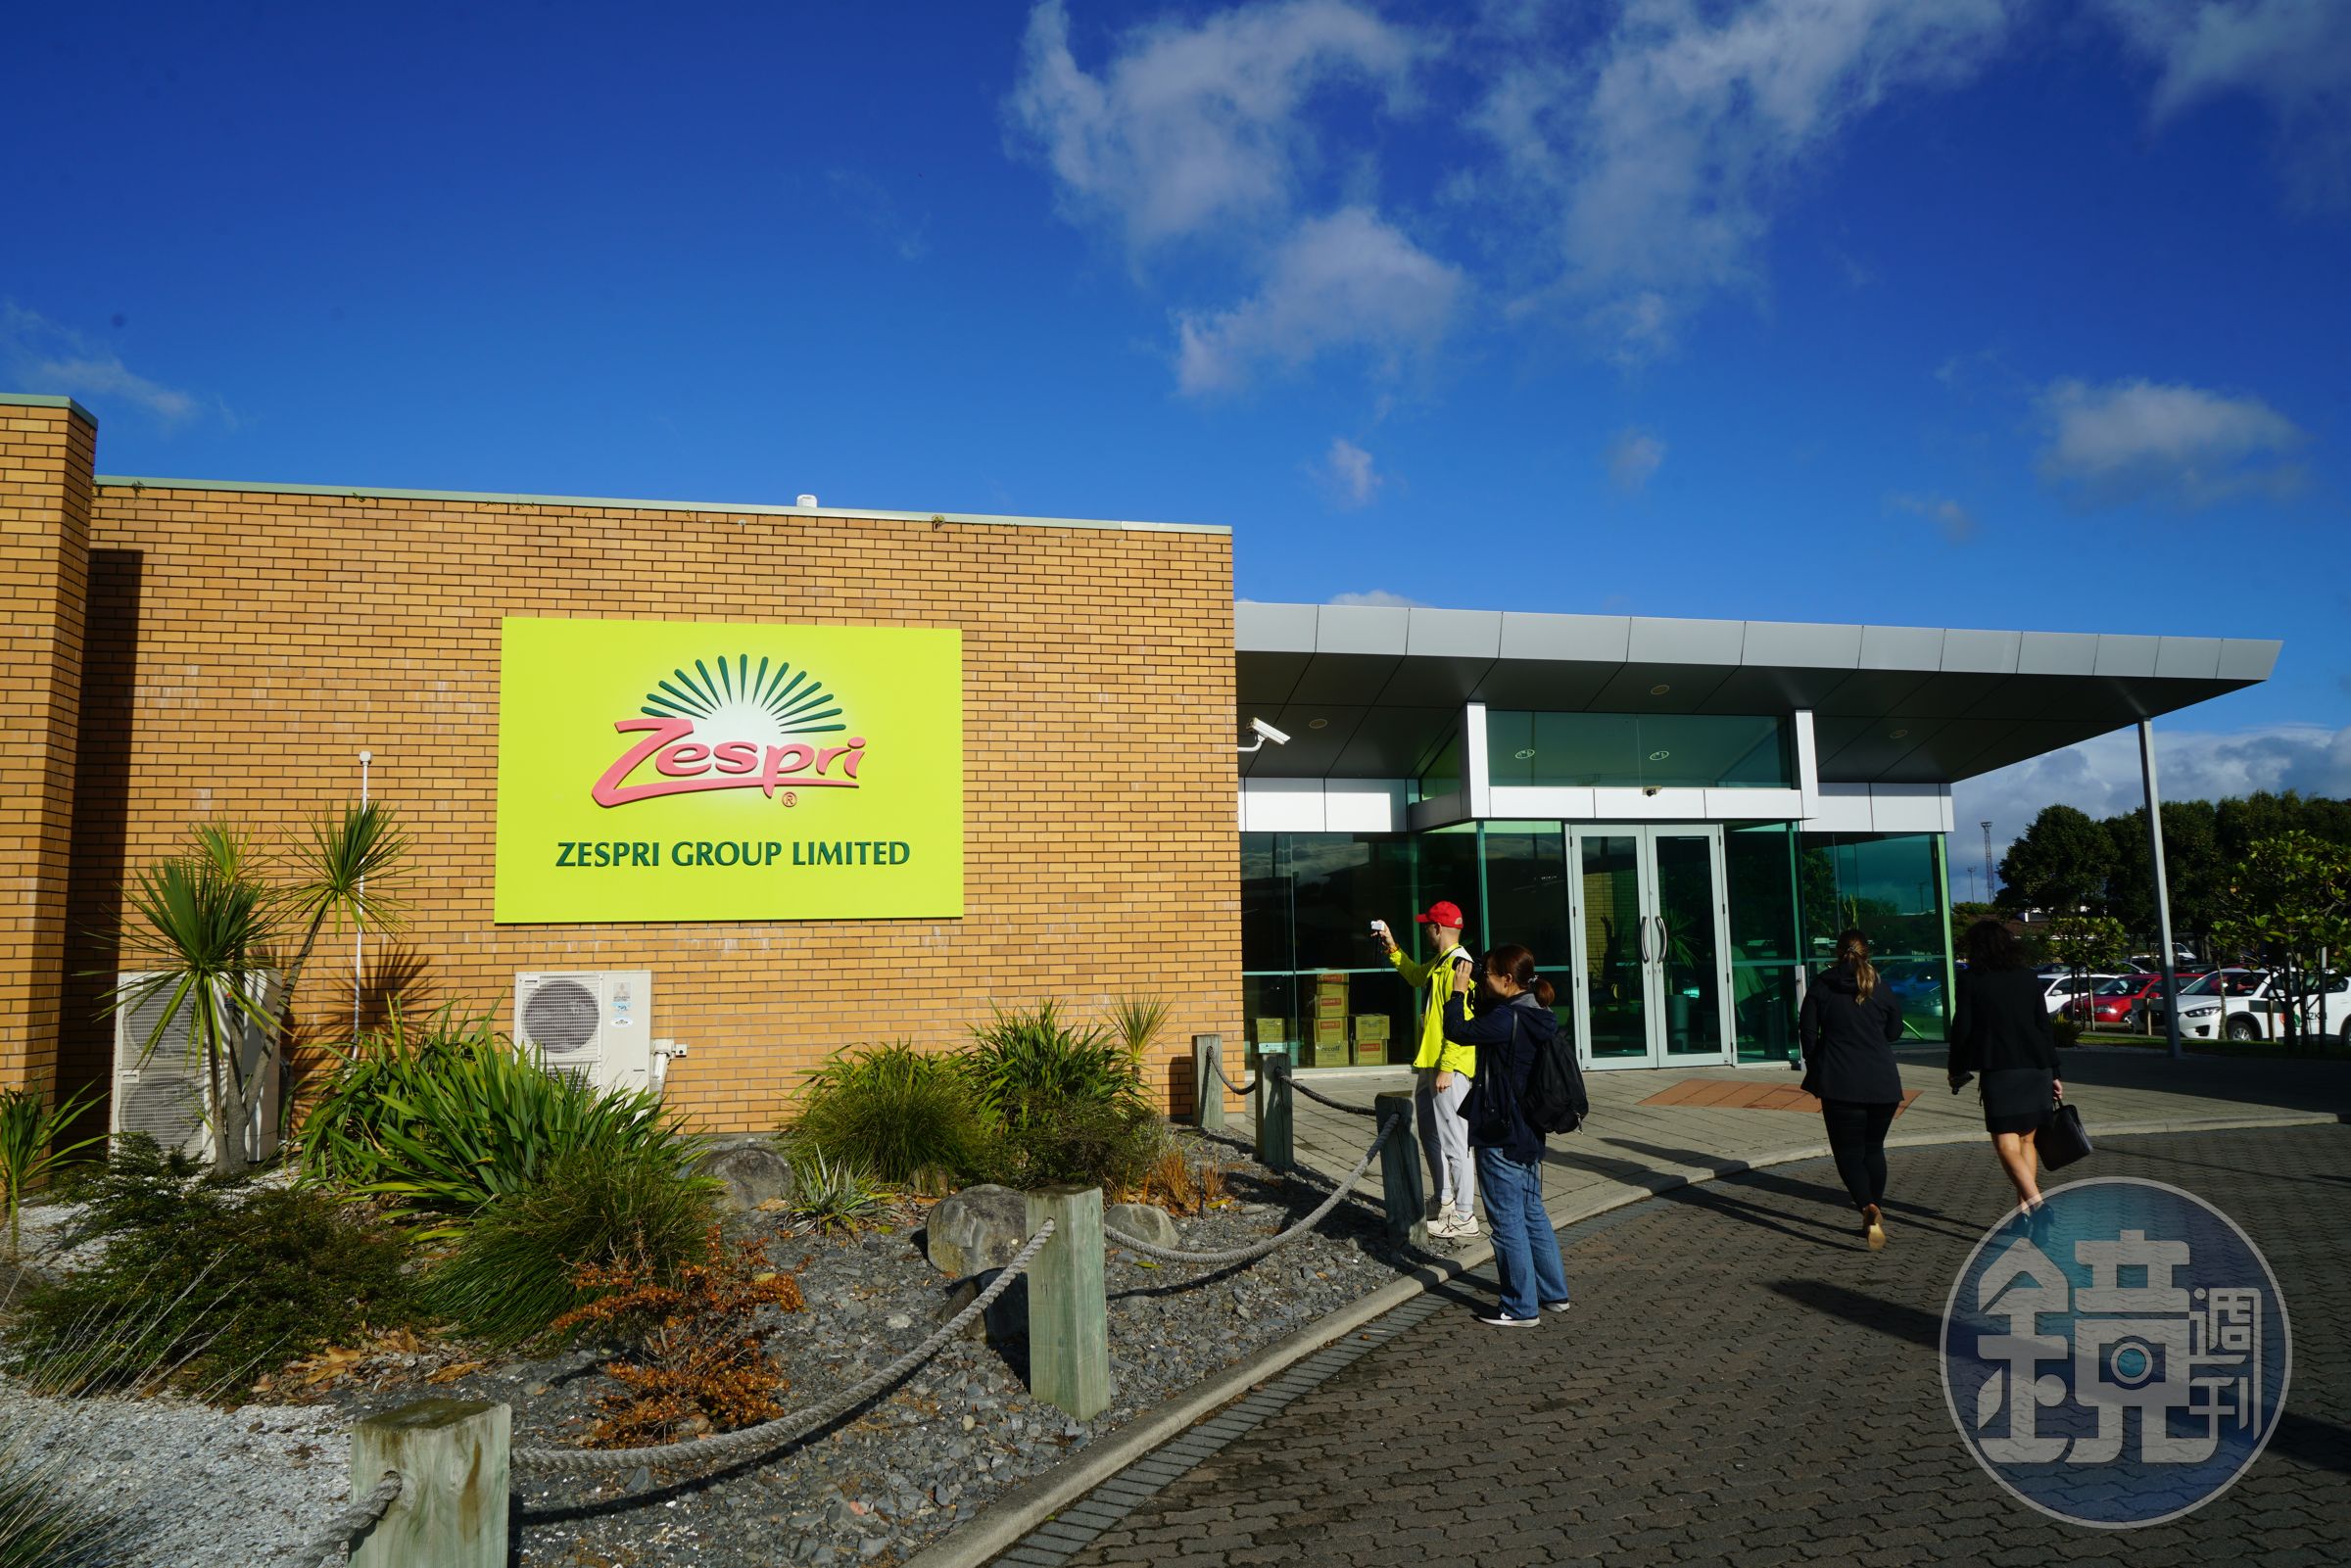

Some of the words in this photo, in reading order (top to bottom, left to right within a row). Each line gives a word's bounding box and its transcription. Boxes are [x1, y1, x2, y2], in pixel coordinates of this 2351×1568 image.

[592, 718, 866, 808] Zespri
[555, 842, 660, 868] ZESPRI
[671, 840, 783, 867] GROUP
[792, 840, 911, 866] LIMITED
